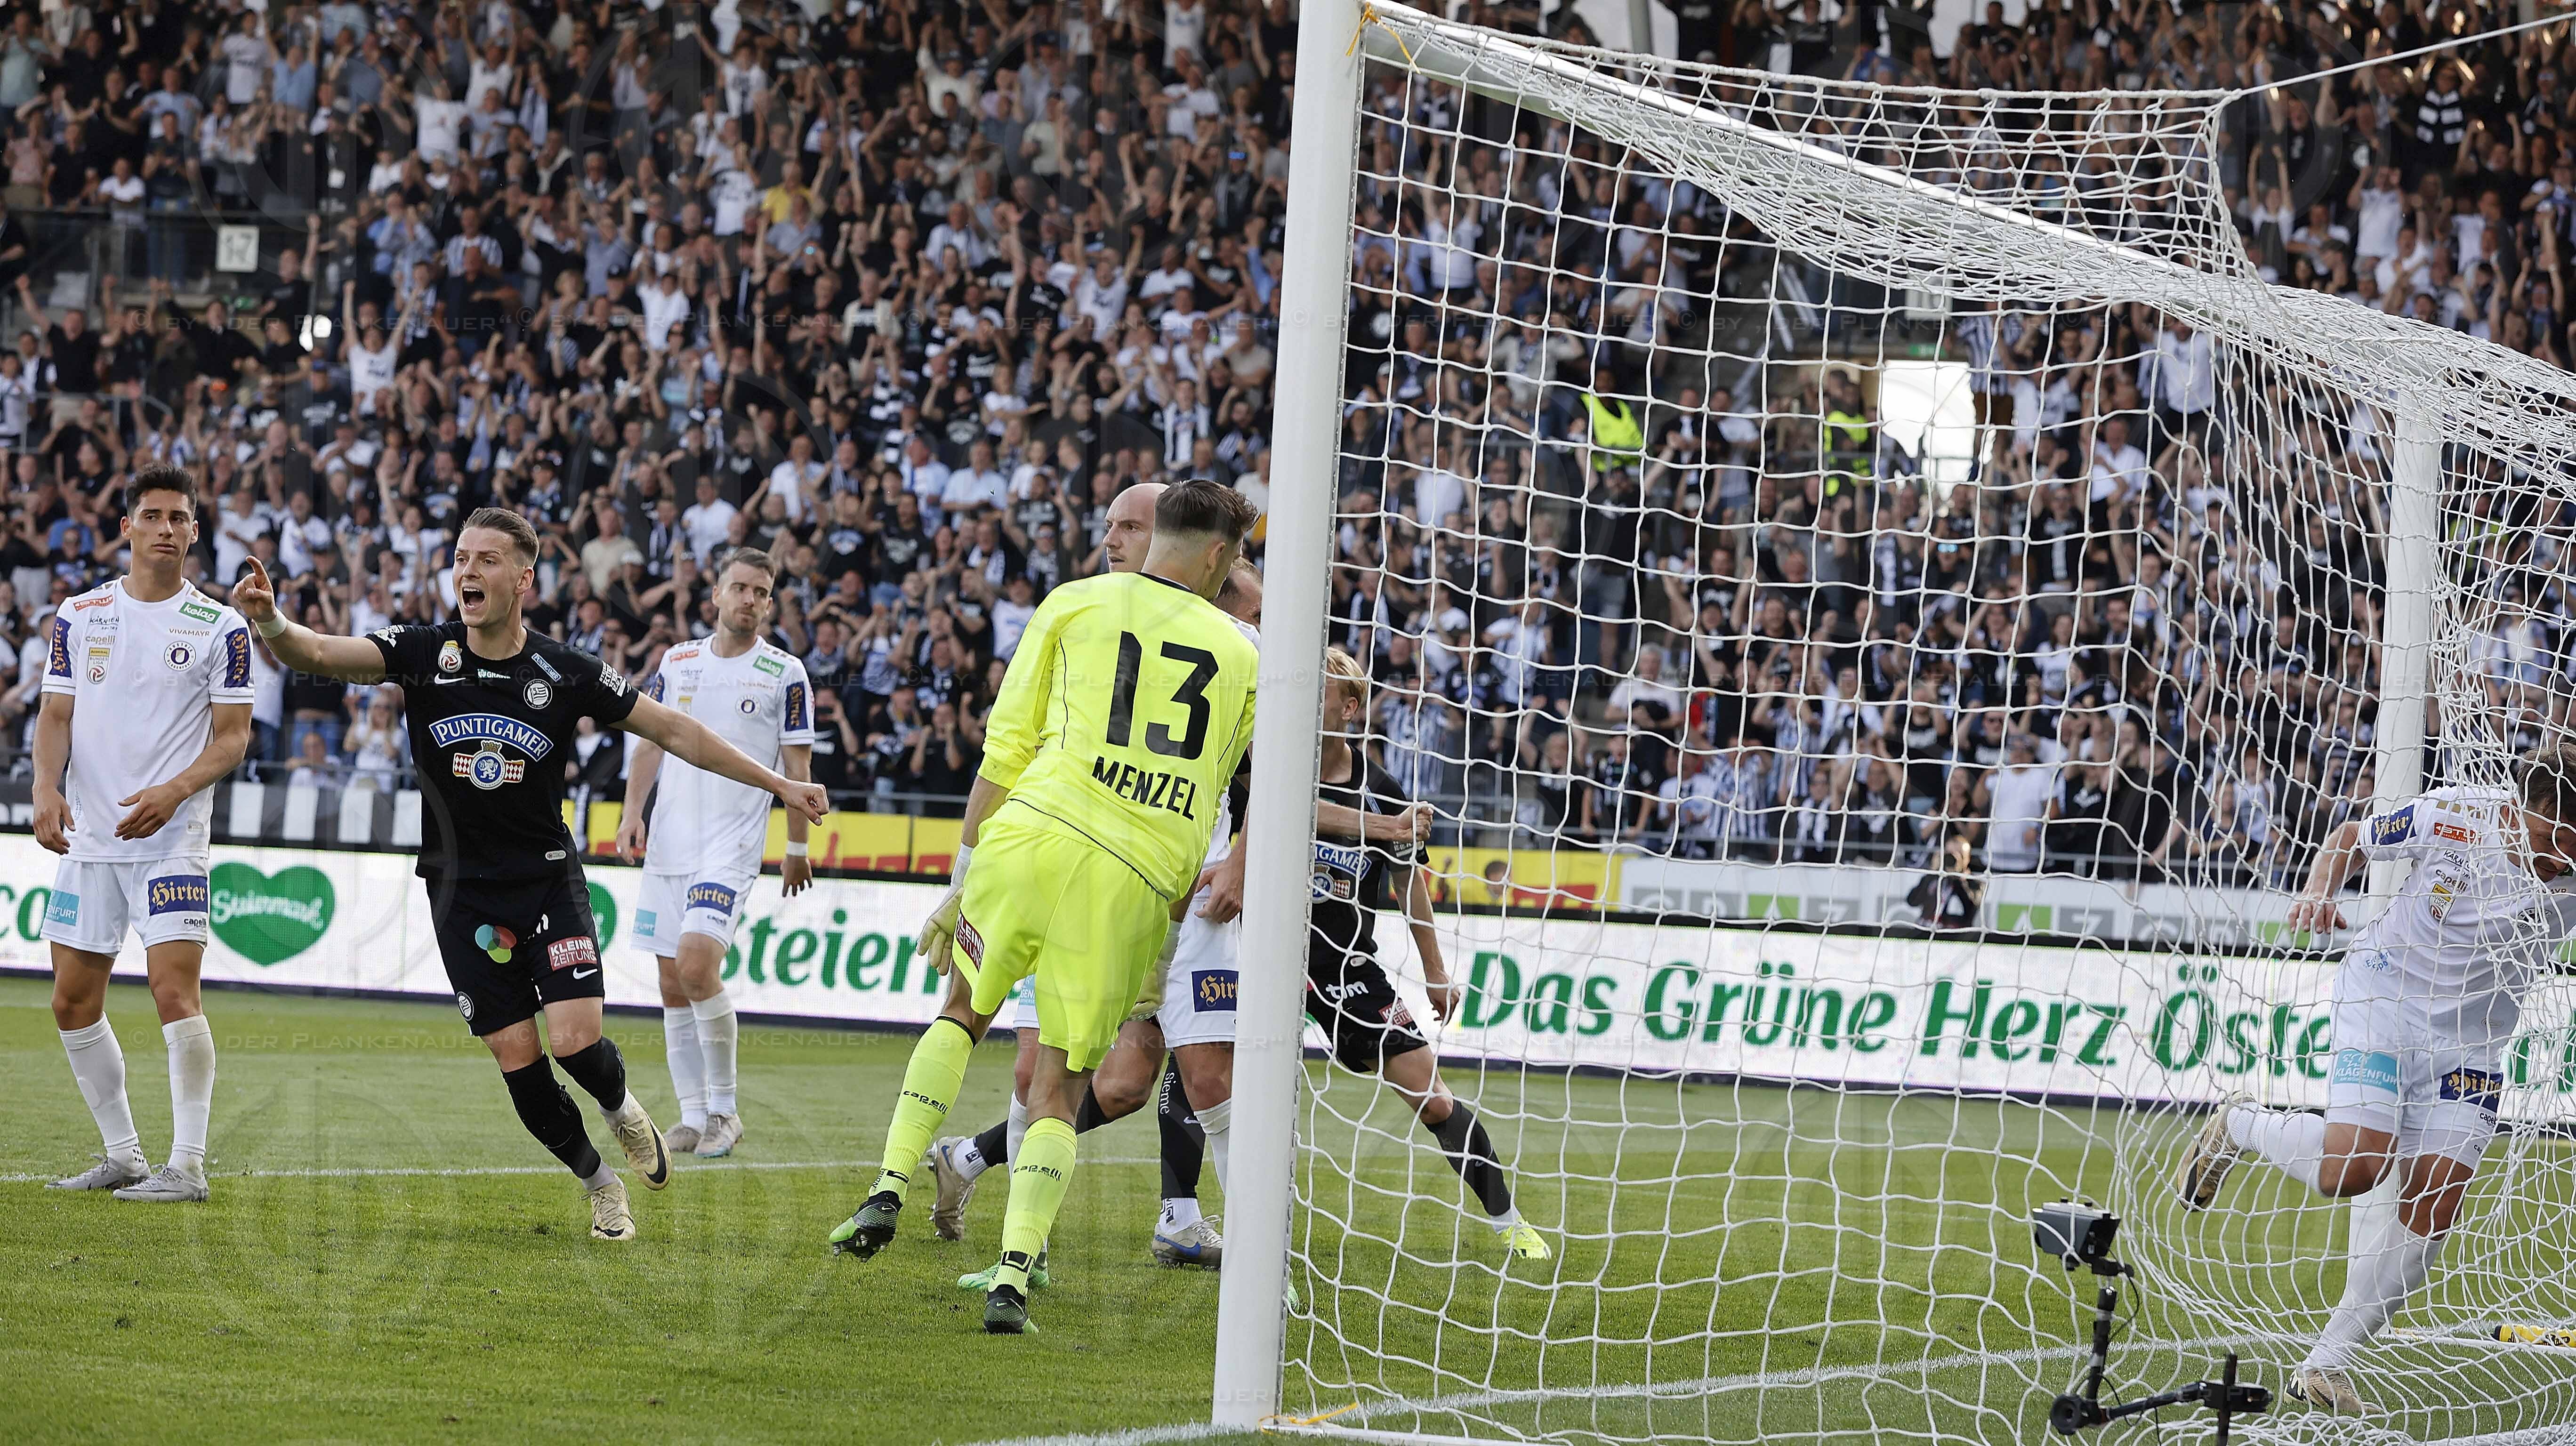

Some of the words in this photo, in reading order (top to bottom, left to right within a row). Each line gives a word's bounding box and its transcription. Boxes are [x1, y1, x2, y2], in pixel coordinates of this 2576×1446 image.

[183, 603, 216, 622] kelag
[85, 635, 116, 645] capelli
[169, 628, 210, 636] VIVAMAYR
[1106, 630, 1219, 760] 13
[435, 717, 548, 757] PUNTIGAMER
[1091, 755, 1196, 822] MENZEL
[2436, 869, 2468, 892] capelli
[152, 881, 206, 909] Hirter
[550, 939, 594, 957] KLEINE
[552, 949, 597, 967] ZEITUNG
[1462, 950, 1616, 1036] Das
[1644, 960, 1897, 1053] Grüne
[1920, 976, 2127, 1065] Herz
[903, 1090, 949, 1115] capelli
[1014, 1165, 1063, 1180] capelli
